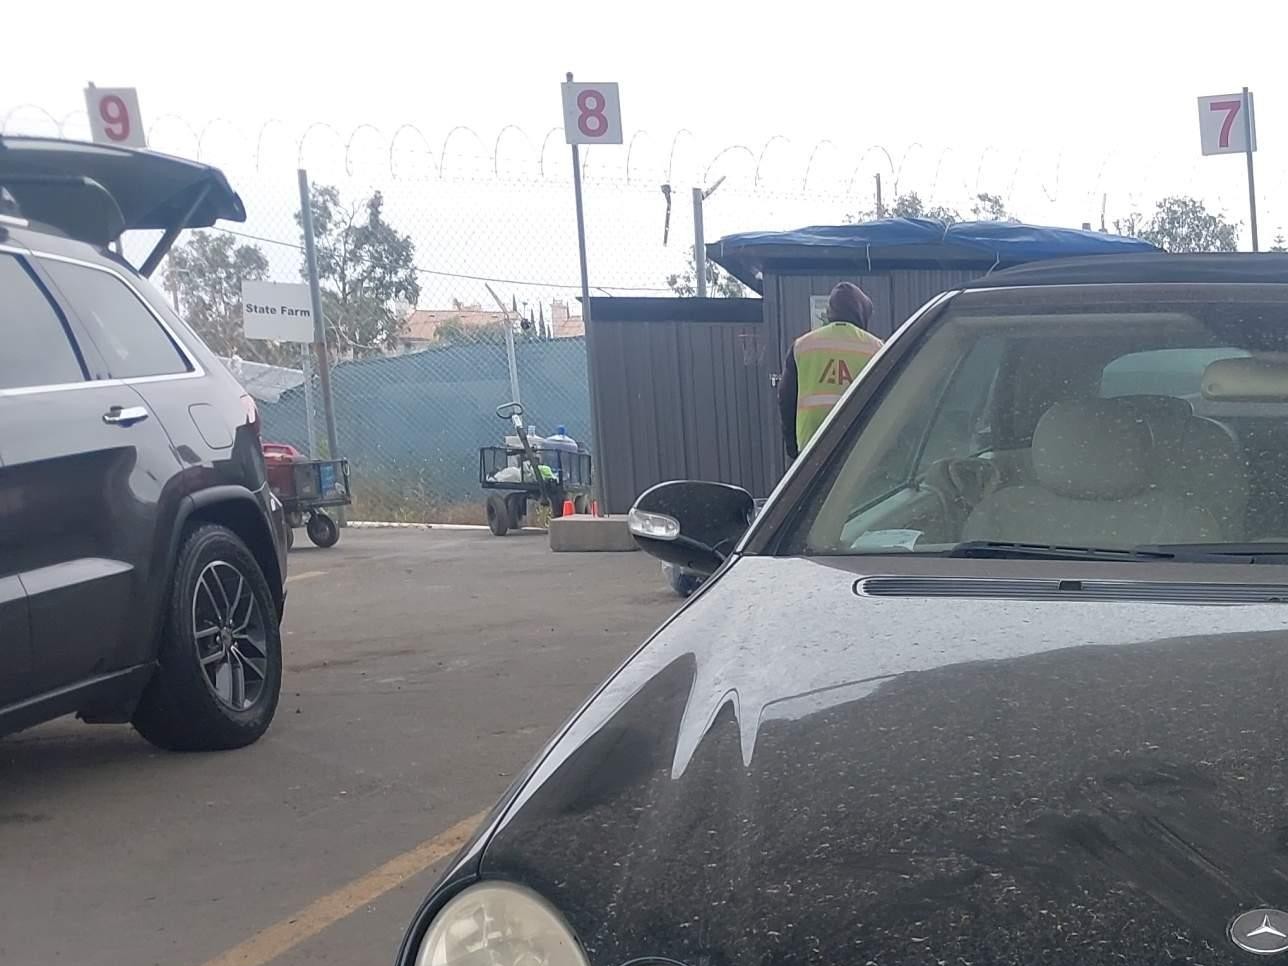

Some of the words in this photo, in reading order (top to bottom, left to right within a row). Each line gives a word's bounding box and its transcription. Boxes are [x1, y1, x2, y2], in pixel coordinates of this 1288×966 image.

[99, 95, 130, 142] 9
[577, 89, 608, 137] 8
[1209, 100, 1241, 148] 7
[246, 304, 277, 314] State
[281, 306, 310, 317] Farm
